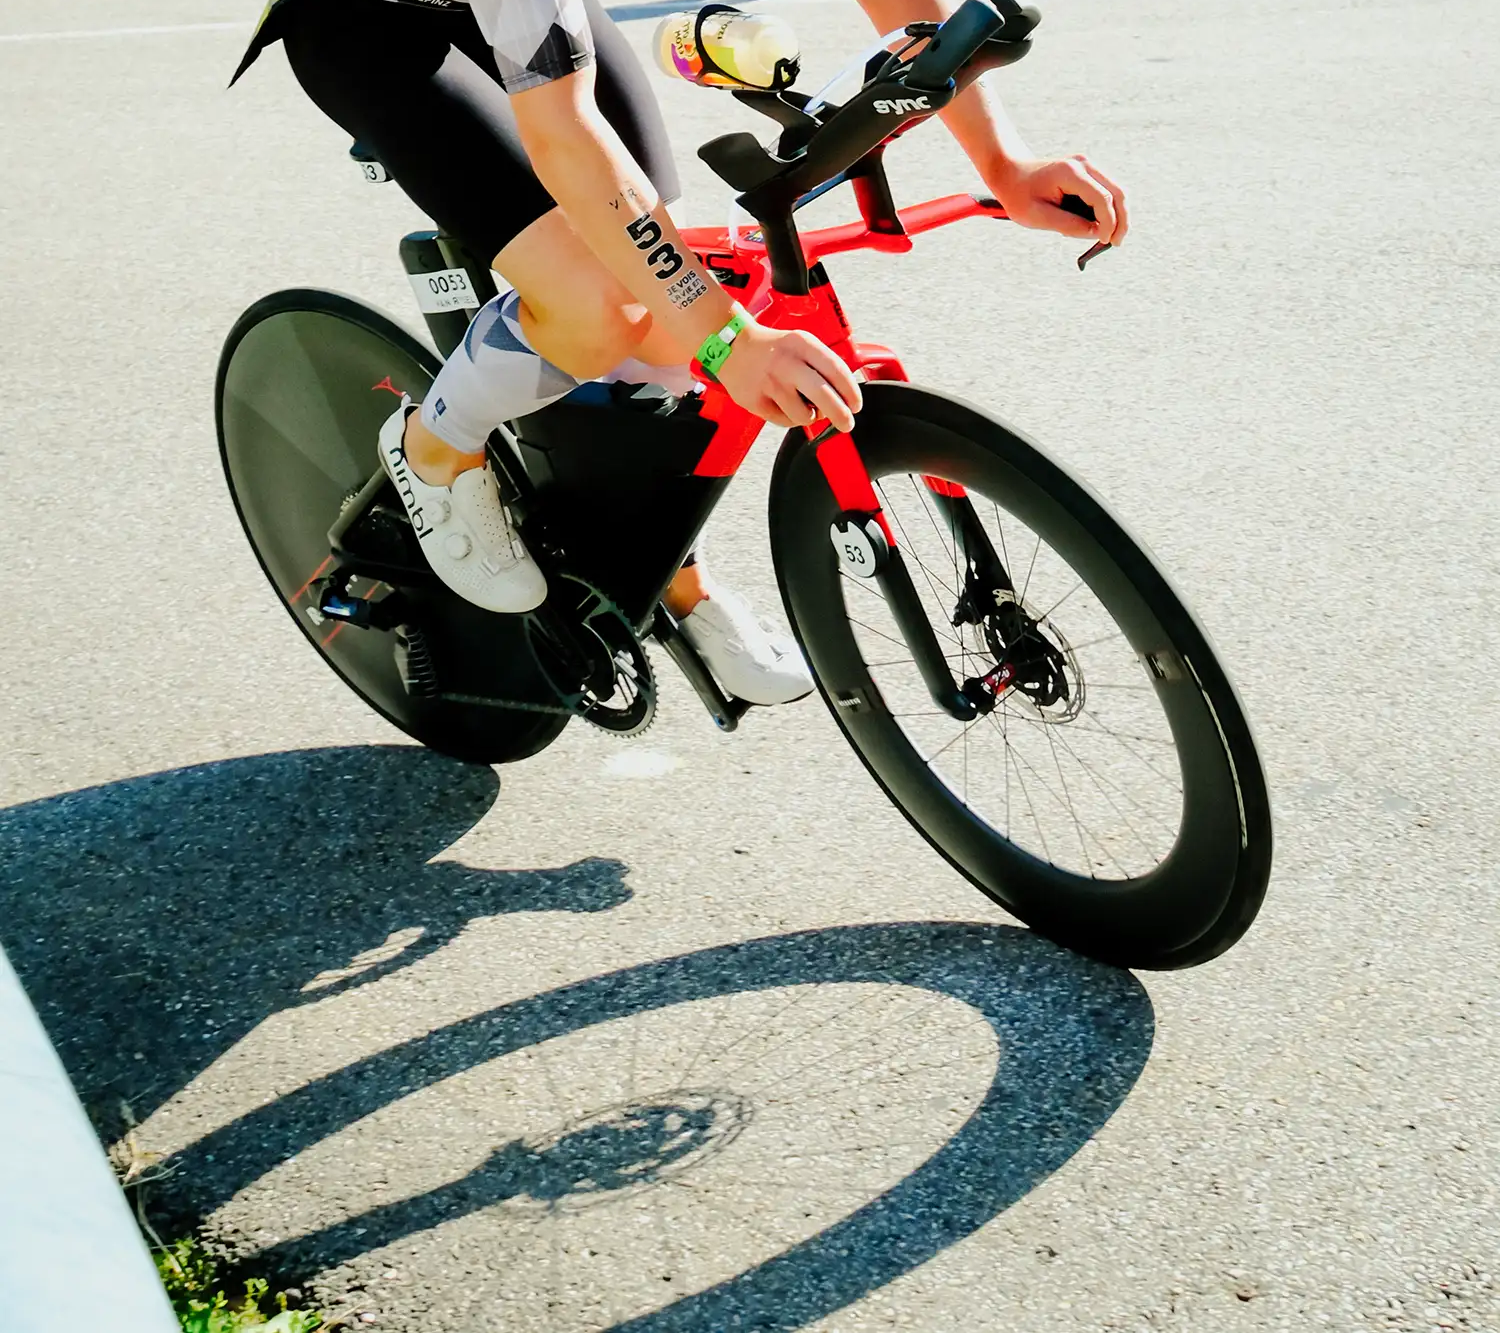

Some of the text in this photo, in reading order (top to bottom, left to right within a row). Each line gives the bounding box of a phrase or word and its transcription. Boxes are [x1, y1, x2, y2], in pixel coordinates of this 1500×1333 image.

[872, 95, 932, 116] sync
[626, 212, 684, 280] 53
[428, 274, 467, 294] 0053
[666, 270, 696, 296] JE VOIS
[680, 285, 693, 297] VIE
[389, 446, 434, 540] nimbl
[844, 544, 866, 565] 53
